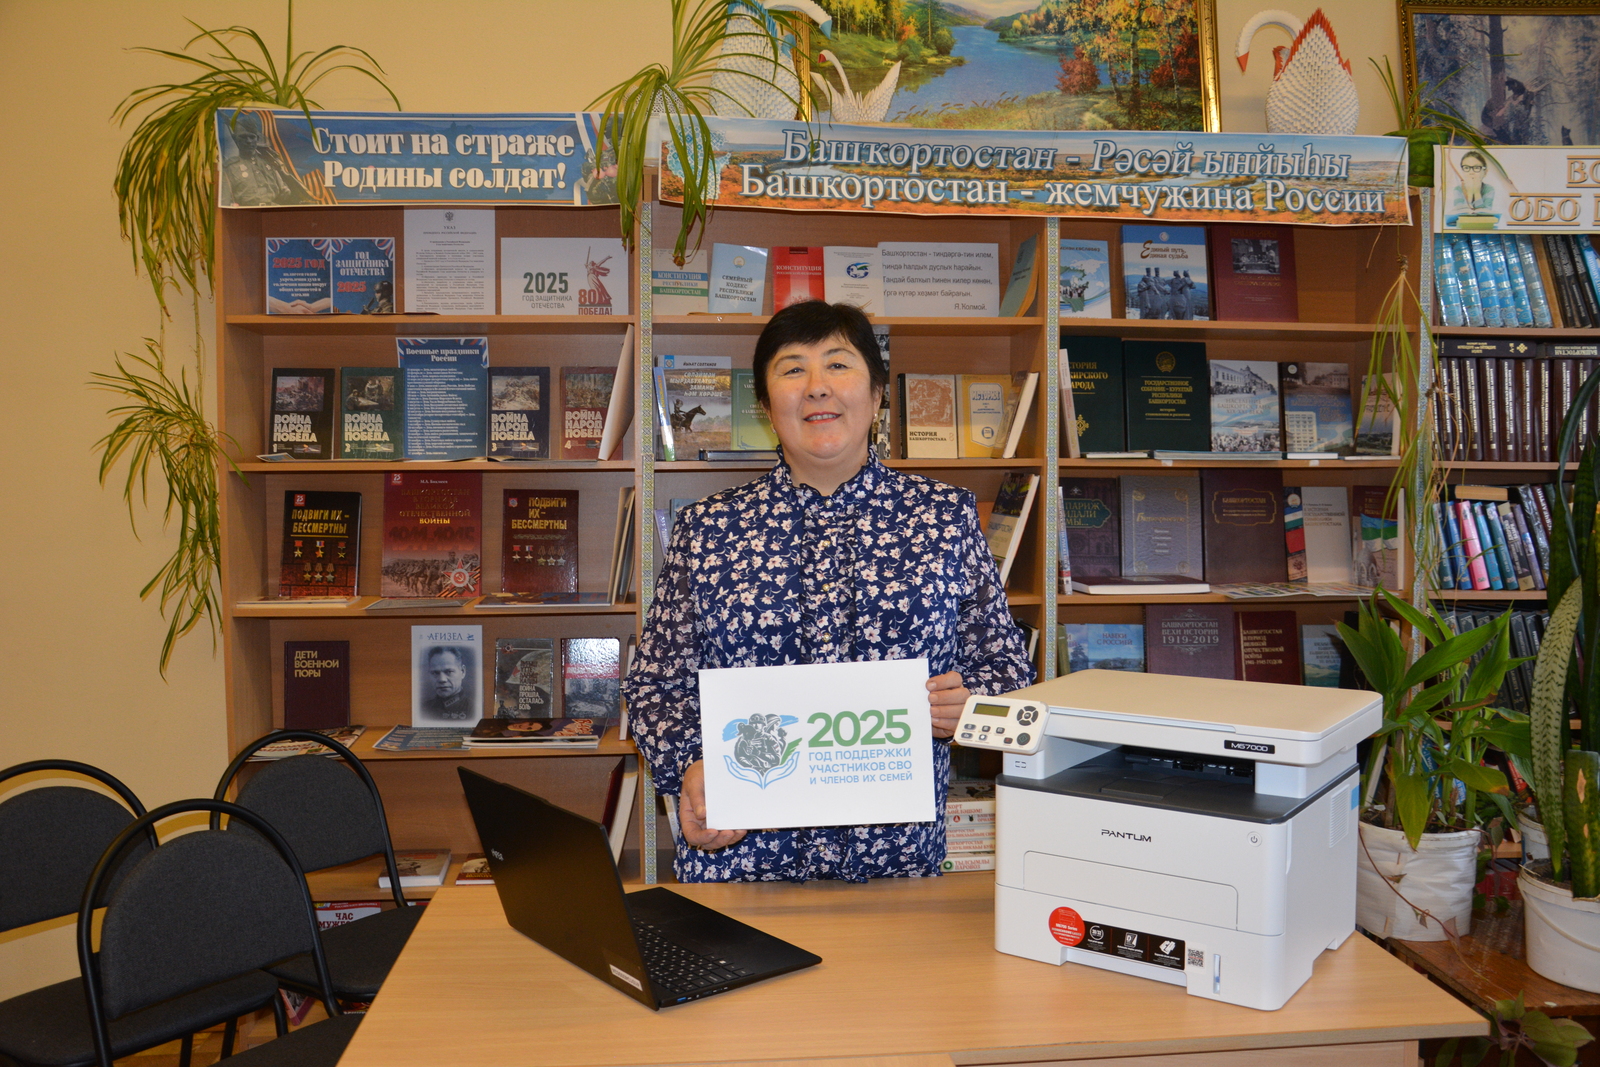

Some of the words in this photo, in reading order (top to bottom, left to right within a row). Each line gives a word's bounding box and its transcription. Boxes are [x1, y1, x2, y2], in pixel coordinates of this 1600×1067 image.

[311, 126, 405, 156] Стоит
[411, 134, 449, 156] на
[455, 133, 575, 164] страже
[1089, 139, 1194, 176] Рәсәй
[1200, 142, 1351, 180] ынйыһы
[323, 160, 443, 193] Родины
[448, 161, 567, 193] солдат!
[739, 163, 1009, 208] Башкортостан
[1044, 180, 1254, 216] жемчужина
[1263, 178, 1386, 214] России
[1508, 197, 1581, 221] ОБО
[354, 251, 370, 260] ГОД
[272, 256, 302, 269] 2025
[335, 260, 390, 269] ЗАЩИТНИКА
[339, 267, 386, 276] ОТЕЧЕСТВА
[776, 264, 822, 272] КОНСТИТУЦИЯ
[657, 272, 702, 281] КОНСТИТУЦИЯ
[722, 274, 753, 284] СЕМЕЙНЫЙ
[336, 281, 367, 293] 2025
[523, 272, 569, 294] 2025
[726, 282, 748, 290] КОДЕКС
[578, 288, 598, 305] 80
[659, 287, 702, 296] БАШКОРТОСТАН
[718, 287, 754, 297] РЕСПУБЛИКИ
[714, 293, 757, 303] БАШКОРТОСТАН
[578, 307, 613, 315] ПОБЕДА!
[440, 348, 480, 356] праздники
[1070, 362, 1098, 370] СТОРИЯ
[1070, 372, 1109, 380] КИРСКОГО
[1071, 381, 1096, 390] АРОДА
[274, 413, 312, 424] ВОЙНА
[344, 412, 383, 423] ВОЙНА
[491, 412, 528, 423] ВОЙНА
[565, 409, 602, 420] ВОЙНА
[274, 424, 312, 433] НАРОД
[344, 423, 383, 432] НАРОД
[491, 422, 528, 432] НАРОД
[565, 420, 602, 430] НАРОД
[273, 432, 318, 442] ПОБЕДА
[344, 432, 390, 442] ПОБЕДА
[491, 431, 536, 441] ПОБЕДА
[565, 428, 604, 438] ПОБЕД
[272, 444, 278, 452] 1
[344, 443, 351, 452] 2
[491, 442, 498, 452] 3
[564, 440, 572, 449] 4
[528, 497, 567, 508] ПОДВИГИ
[1066, 502, 1101, 510] ПАРИЖ
[292, 509, 329, 522] ПОДВИГИ
[330, 512, 342, 521] ИХ
[528, 508, 540, 518] ИХ
[1064, 510, 1097, 518] ИДАЛИ
[419, 516, 450, 524] ВОЙНЫ
[512, 519, 568, 530] БЕССМЕРТНЫ
[292, 522, 347, 534] БЕССМЕРТНЫ
[1162, 621, 1219, 629] БАШКОРТОСТАН
[1102, 632, 1128, 640] НАВЕКИ
[1162, 628, 1183, 636] ВЕХИ
[1184, 628, 1219, 636] ИСТОРИИ
[1162, 635, 1220, 645] 1919-2019
[294, 650, 318, 660] ДЕТИ
[294, 659, 340, 669] ВОЕННОЙ
[294, 669, 321, 678] ПОРЫ
[519, 684, 536, 692] ВОЙНА
[806, 708, 912, 748] 2025
[1230, 742, 1270, 752] M6700D
[808, 750, 832, 762] ГОД
[836, 748, 912, 762] ПОДДЕРЖКИ
[809, 761, 886, 774] УЧАСТНИКОВ
[888, 760, 912, 770] СВО
[810, 776, 817, 785] И
[820, 774, 860, 784] ЧЛЕНОВ
[862, 774, 876, 782] ИХ
[879, 771, 913, 782] СЕМЕЙ
[1100, 828, 1152, 843] PANTUM
[335, 912, 354, 921] ЧАС
